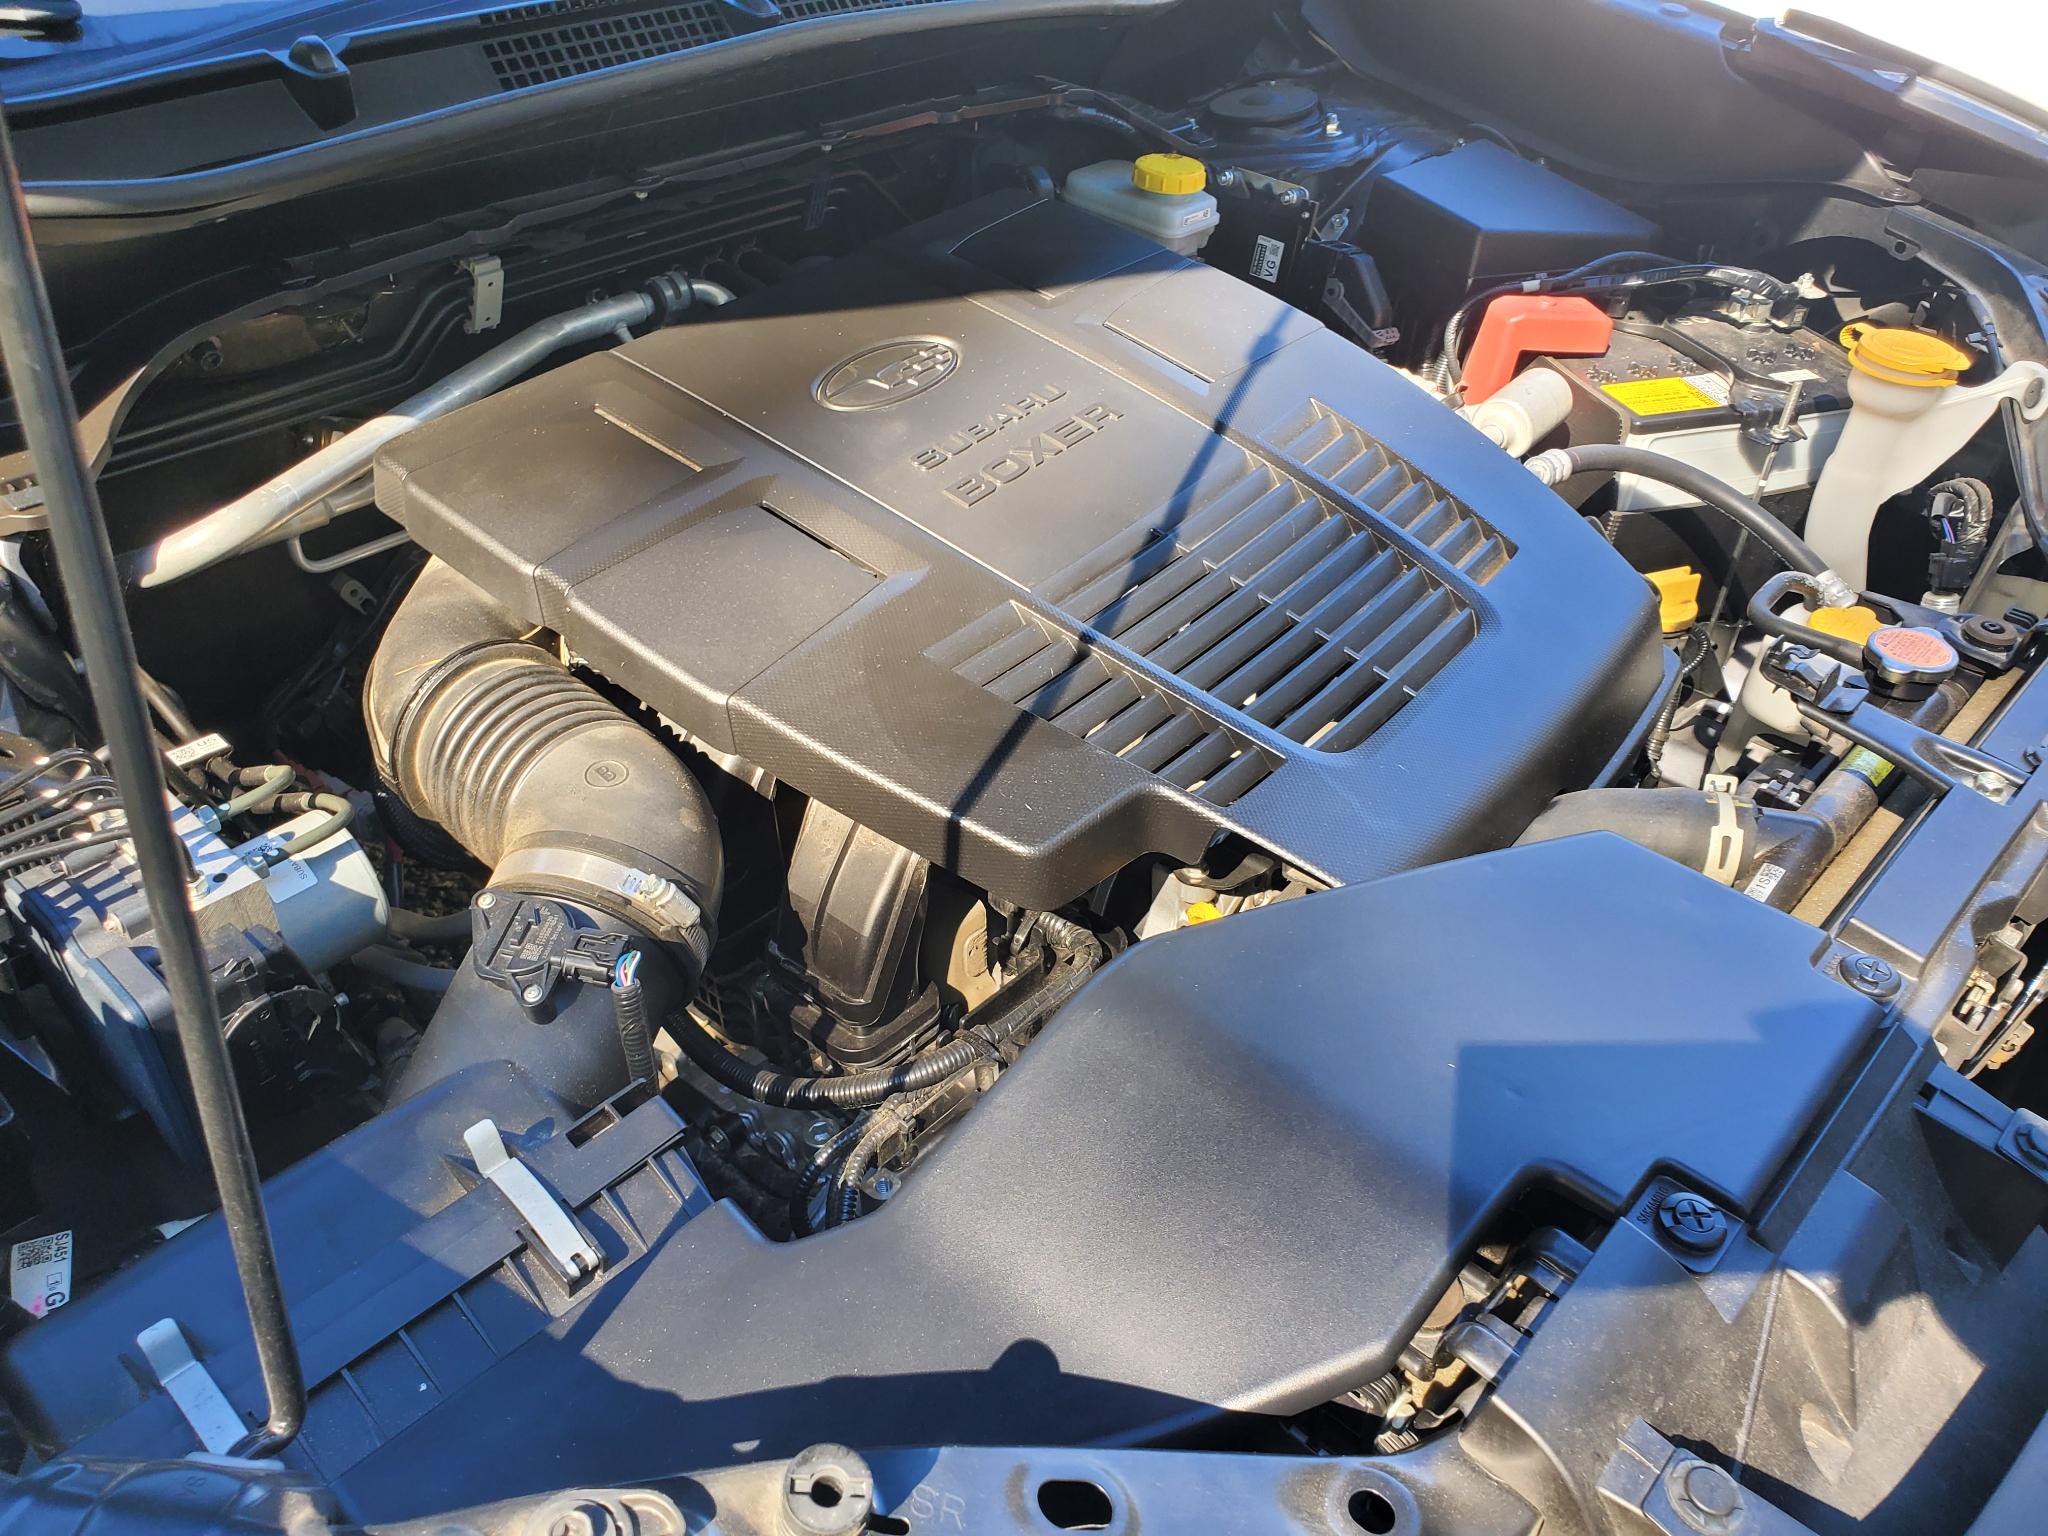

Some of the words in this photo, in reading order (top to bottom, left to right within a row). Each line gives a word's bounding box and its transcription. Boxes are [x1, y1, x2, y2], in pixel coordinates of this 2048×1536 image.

[1264, 260, 1276, 277] VG
[911, 385, 1067, 471] SUBARU
[943, 405, 1124, 508] BOXER
[593, 766, 616, 783] B
[54, 1233, 69, 1263] SJ451
[45, 1291, 65, 1307] G
[910, 1484, 966, 1531] SR
